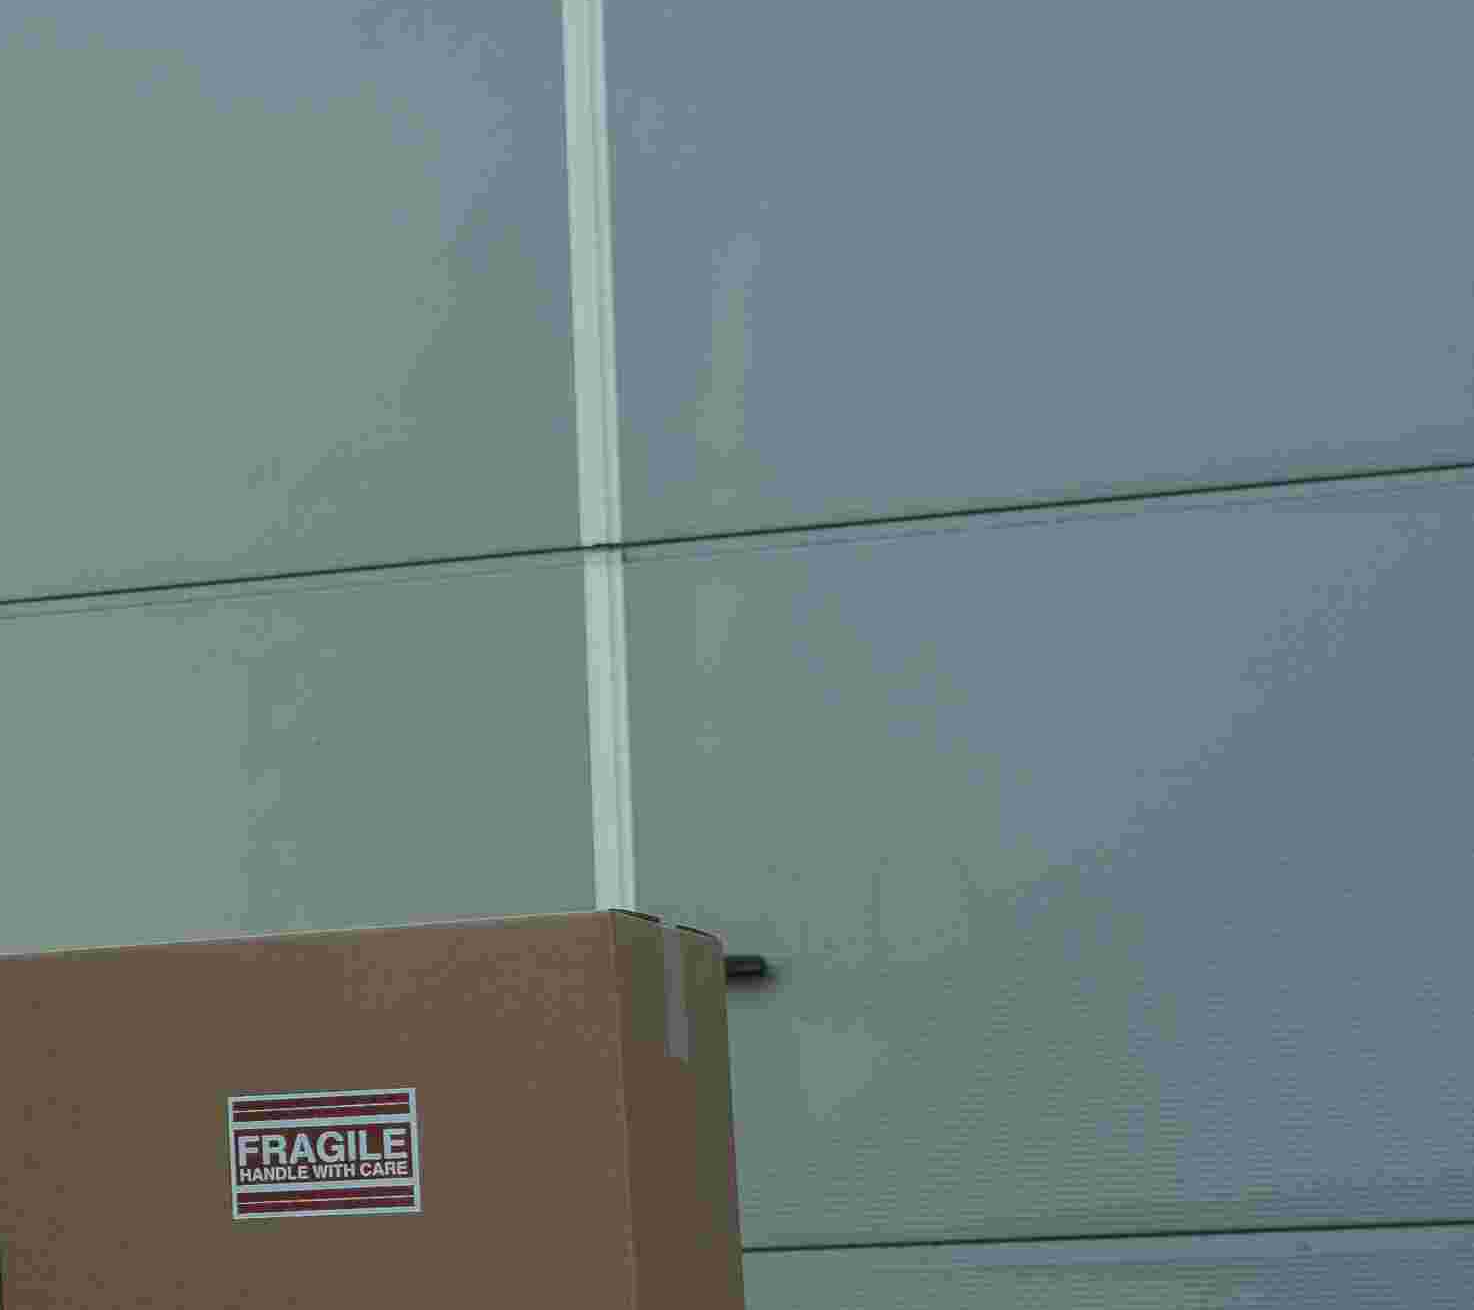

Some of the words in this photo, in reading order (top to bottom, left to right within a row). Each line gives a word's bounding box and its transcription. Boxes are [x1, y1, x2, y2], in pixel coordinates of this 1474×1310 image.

[237, 1127, 408, 1167] FRAGILE
[240, 1165, 309, 1183] HANDLE
[312, 1162, 355, 1179] WITH
[359, 1159, 409, 1177] CARE
